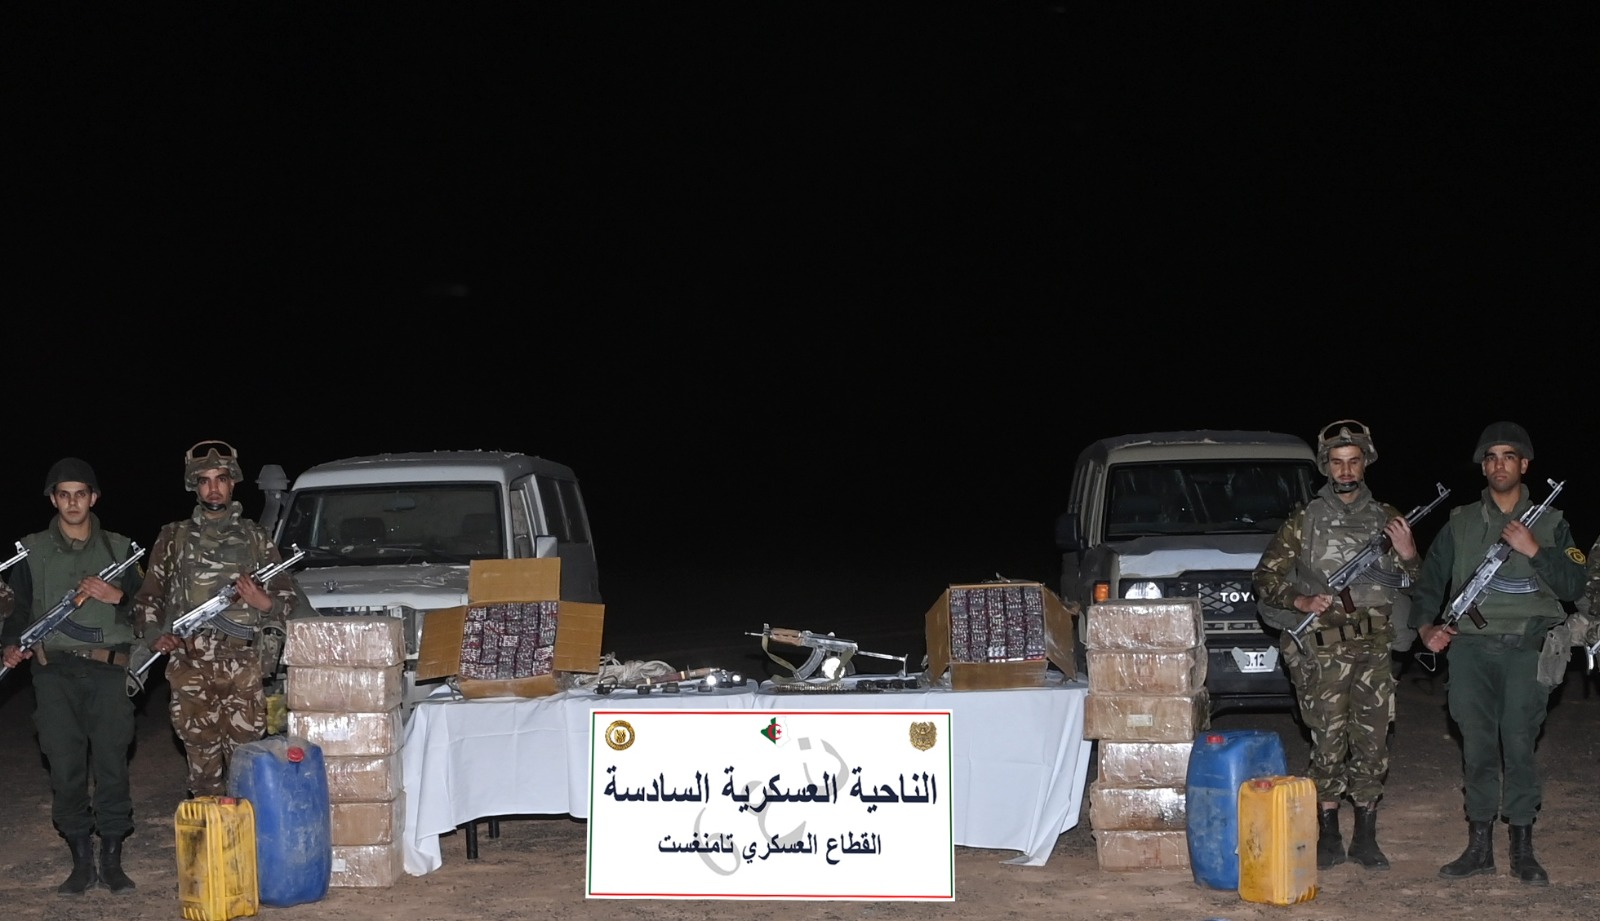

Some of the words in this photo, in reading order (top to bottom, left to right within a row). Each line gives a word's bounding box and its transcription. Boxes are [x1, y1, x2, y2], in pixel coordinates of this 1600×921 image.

[1220, 592, 1255, 602] TOY
[603, 764, 710, 803] السادسة
[721, 765, 838, 813] العسكرية
[850, 765, 937, 814] الناحية
[657, 832, 734, 853] تامنغست
[742, 832, 818, 864] العسكري
[825, 832, 882, 865] القطاع
